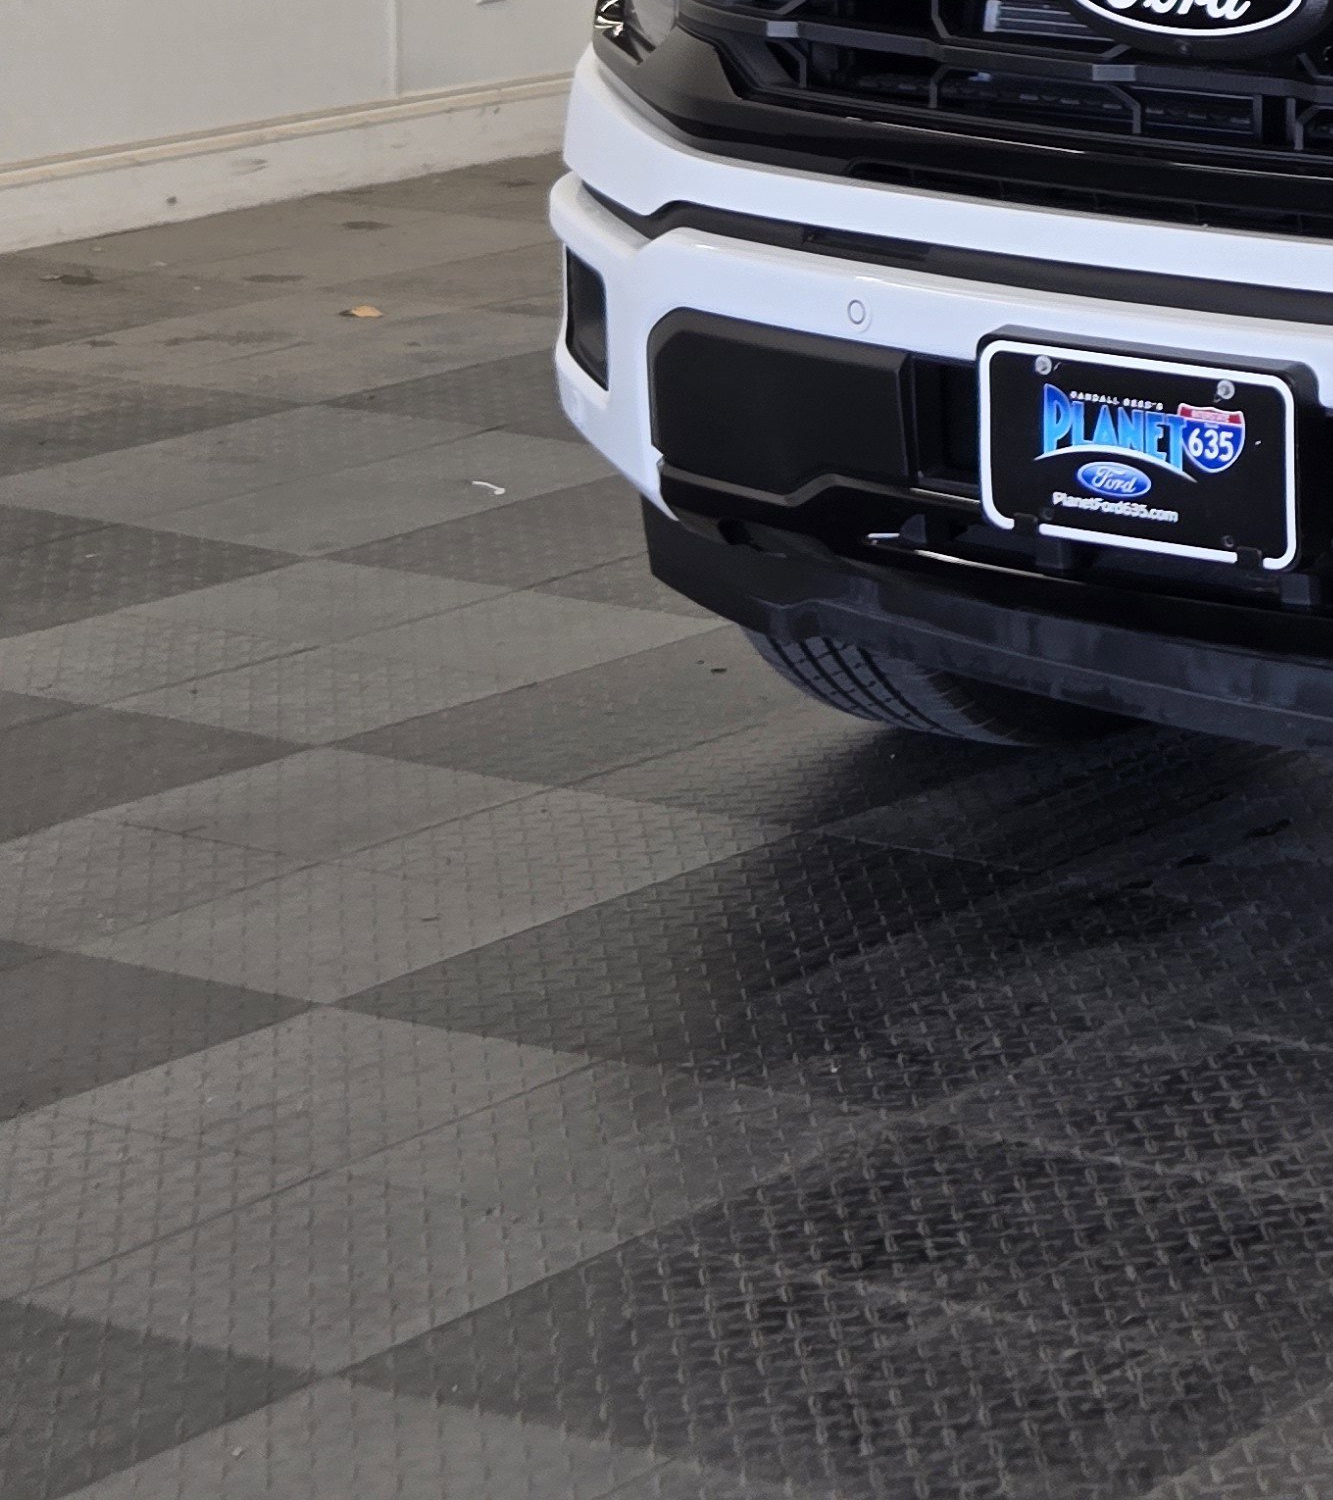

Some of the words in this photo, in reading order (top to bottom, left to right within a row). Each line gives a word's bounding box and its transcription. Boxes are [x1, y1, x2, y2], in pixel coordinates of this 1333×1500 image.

[1043, 383, 1186, 473] PLANET
[1188, 428, 1234, 462] 635
[1091, 467, 1137, 494] Ford
